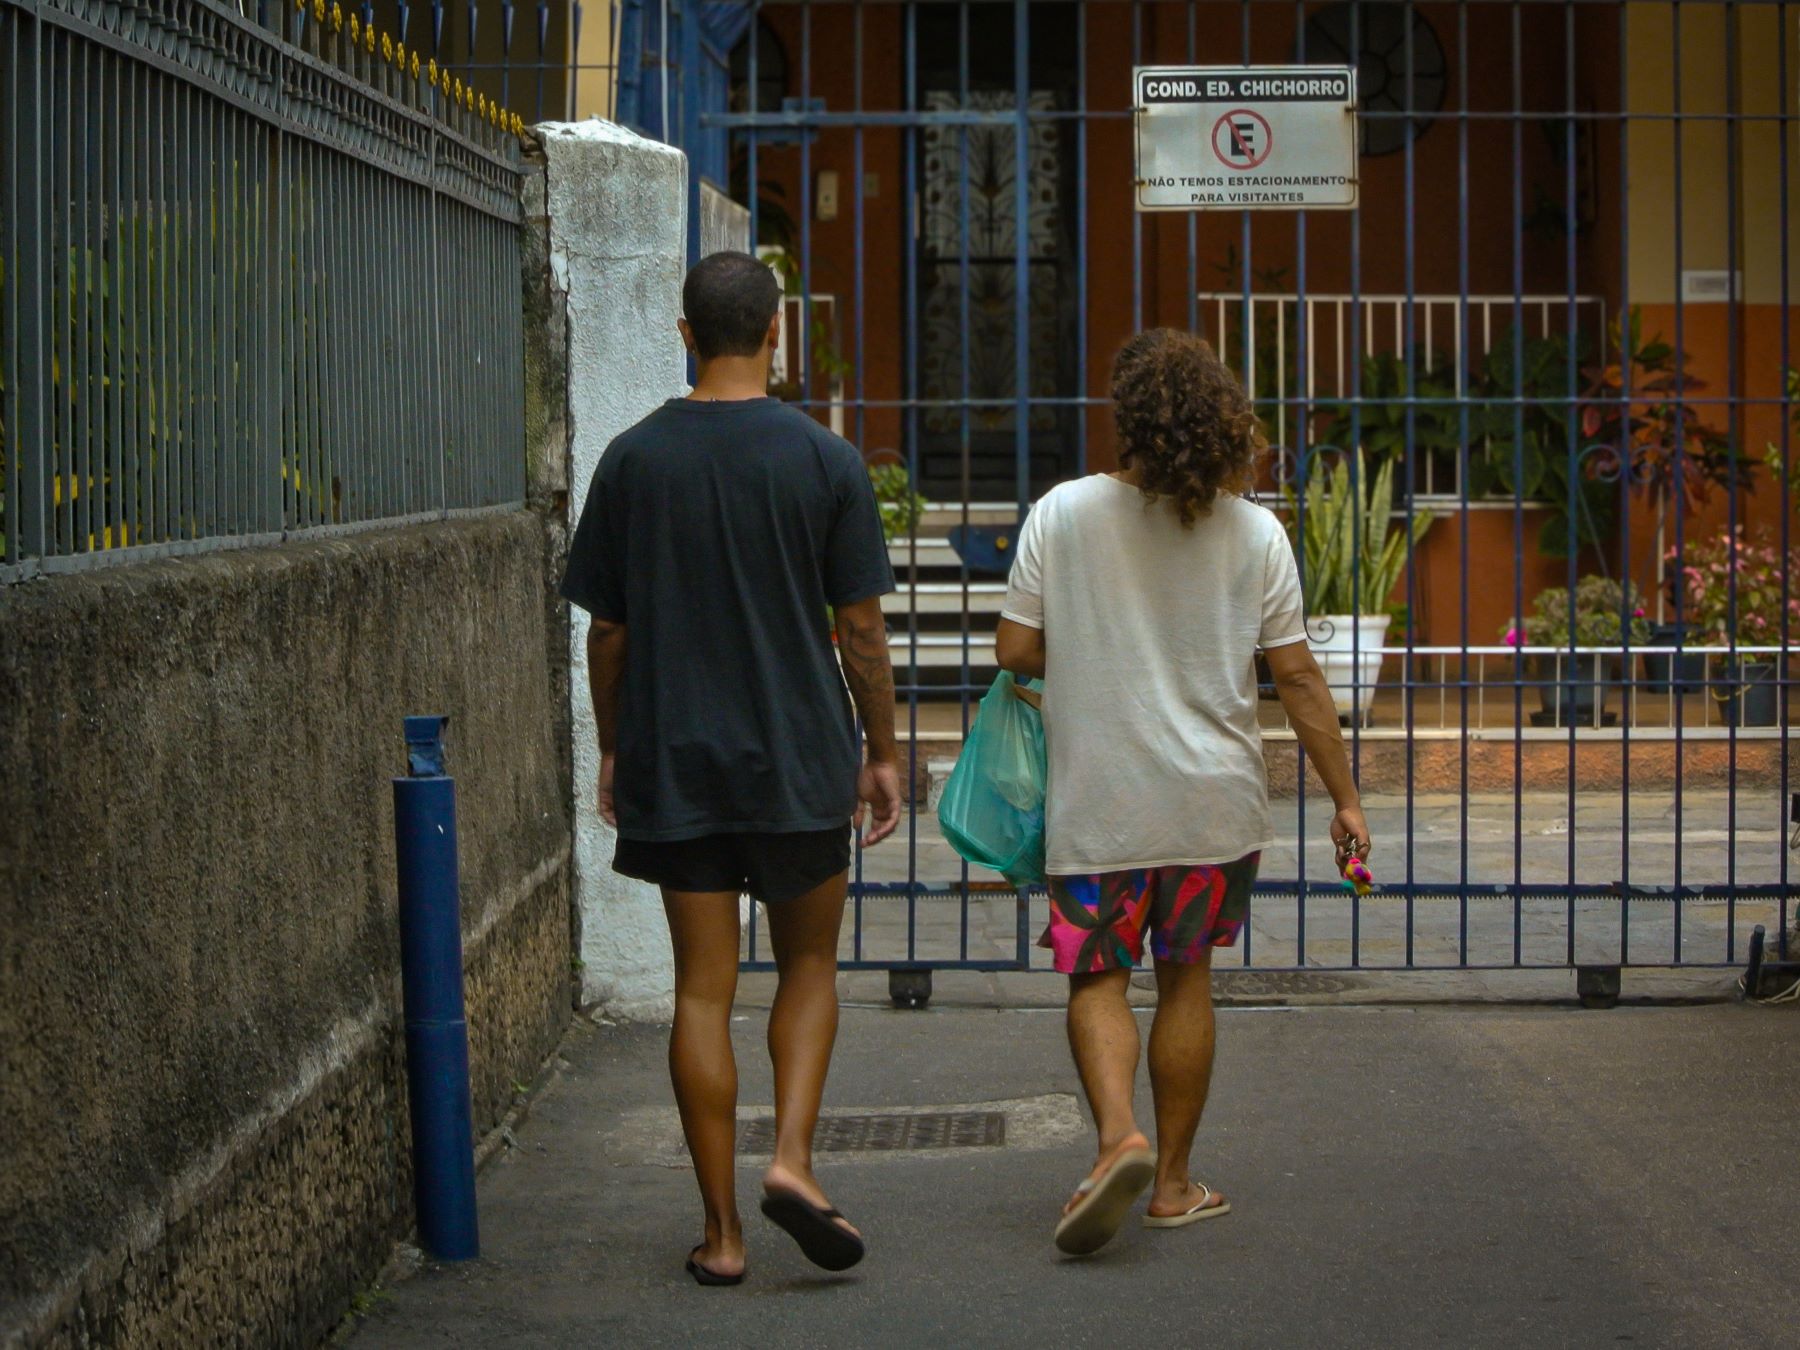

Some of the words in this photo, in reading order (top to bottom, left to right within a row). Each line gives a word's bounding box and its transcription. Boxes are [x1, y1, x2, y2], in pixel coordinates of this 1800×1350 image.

[1146, 81, 1201, 98] COND.
[1206, 80, 1235, 97] ED.
[1240, 79, 1345, 96] CHICHORRO
[1230, 123, 1255, 156] E
[1148, 176, 1175, 187] NÃO
[1179, 177, 1224, 187] TEMOS
[1228, 176, 1346, 187] ESTACIONAMENTO
[1191, 193, 1224, 203] PARA
[1228, 192, 1304, 202] VISITANTES
